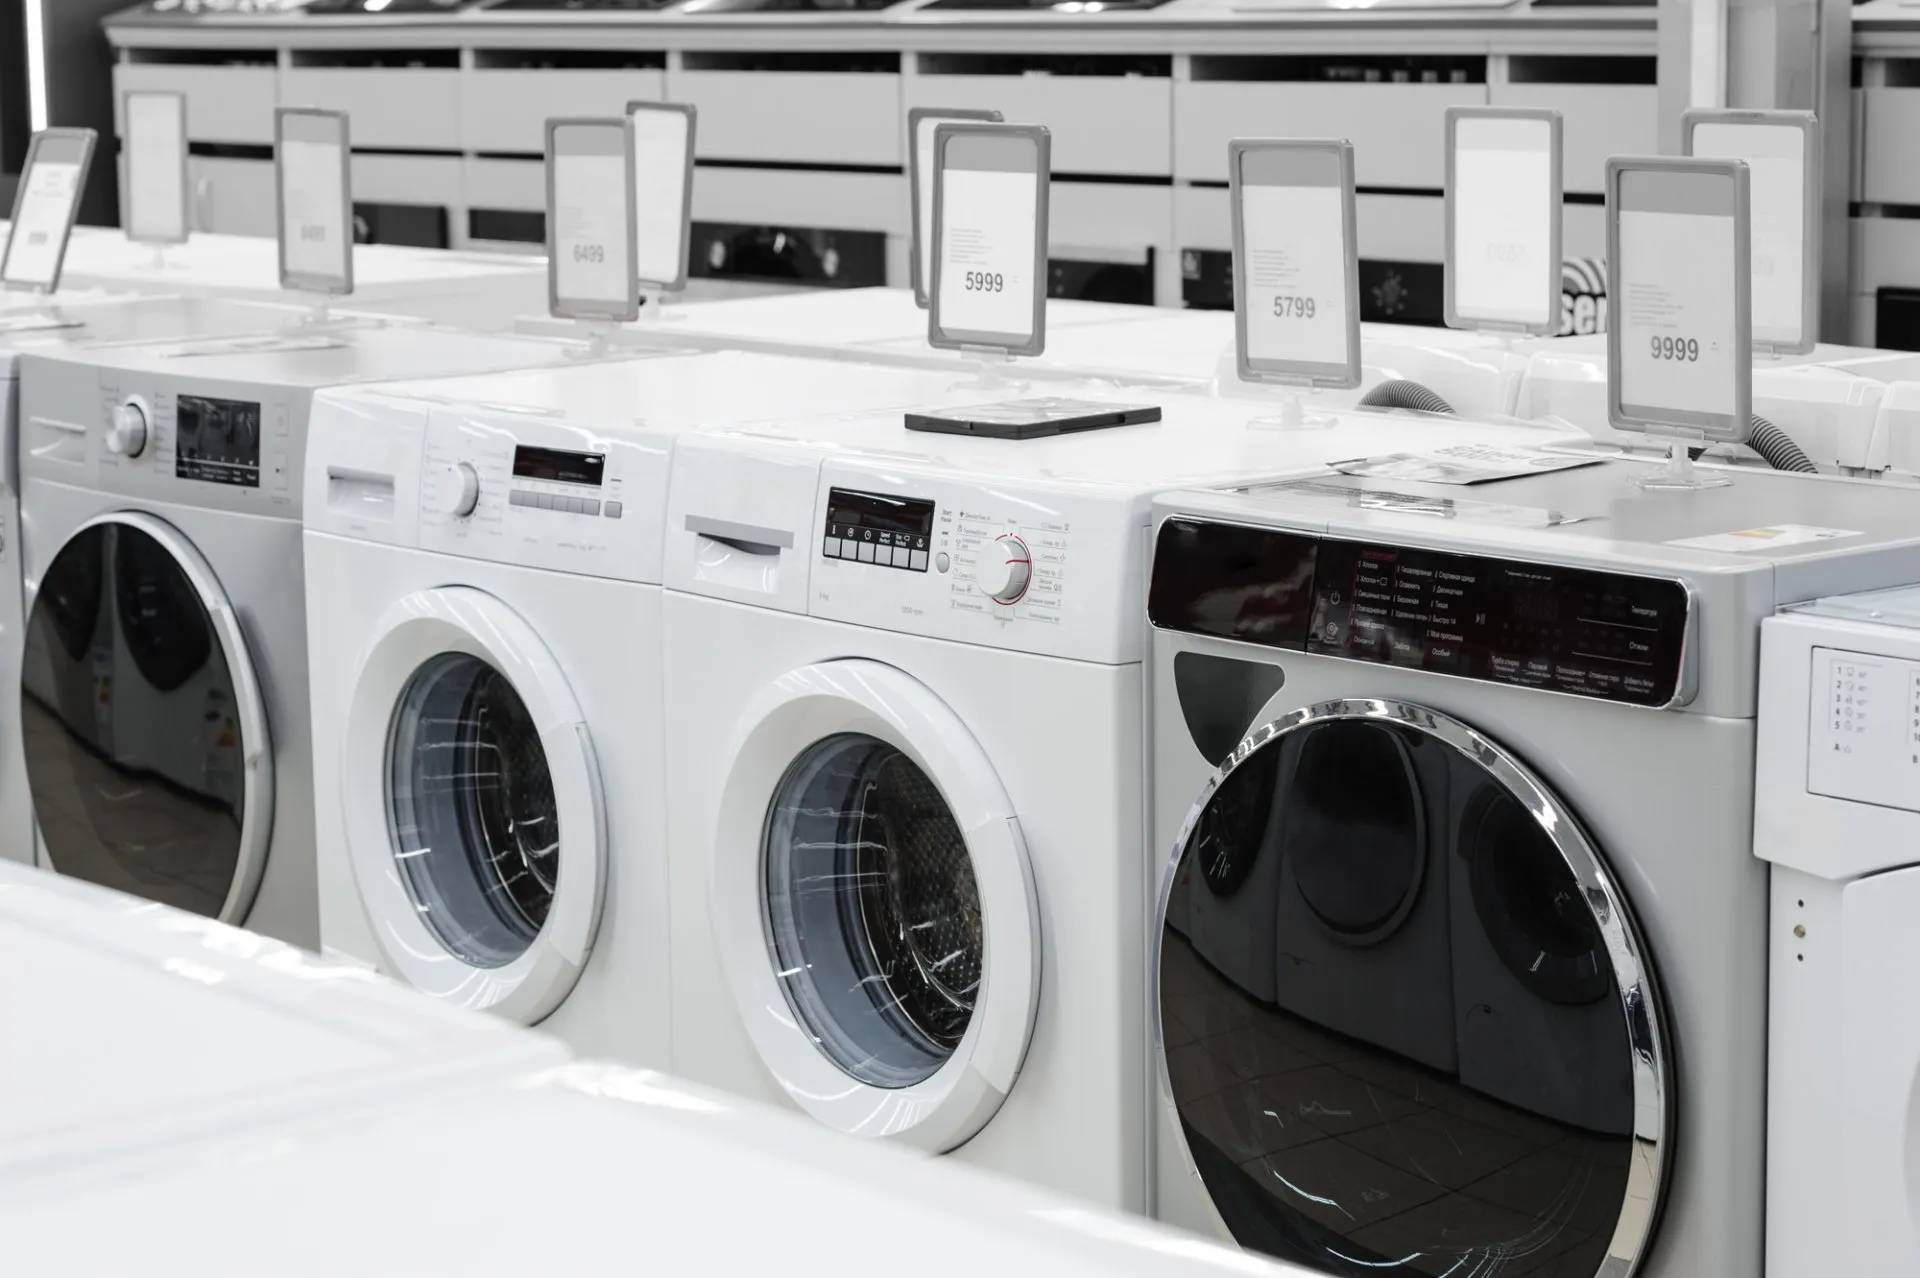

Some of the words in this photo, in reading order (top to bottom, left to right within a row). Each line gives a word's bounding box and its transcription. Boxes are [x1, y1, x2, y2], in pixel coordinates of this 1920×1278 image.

[965, 271, 1003, 292] 5999
[1273, 296, 1316, 318] 5799
[1651, 335, 1699, 362] 9999
